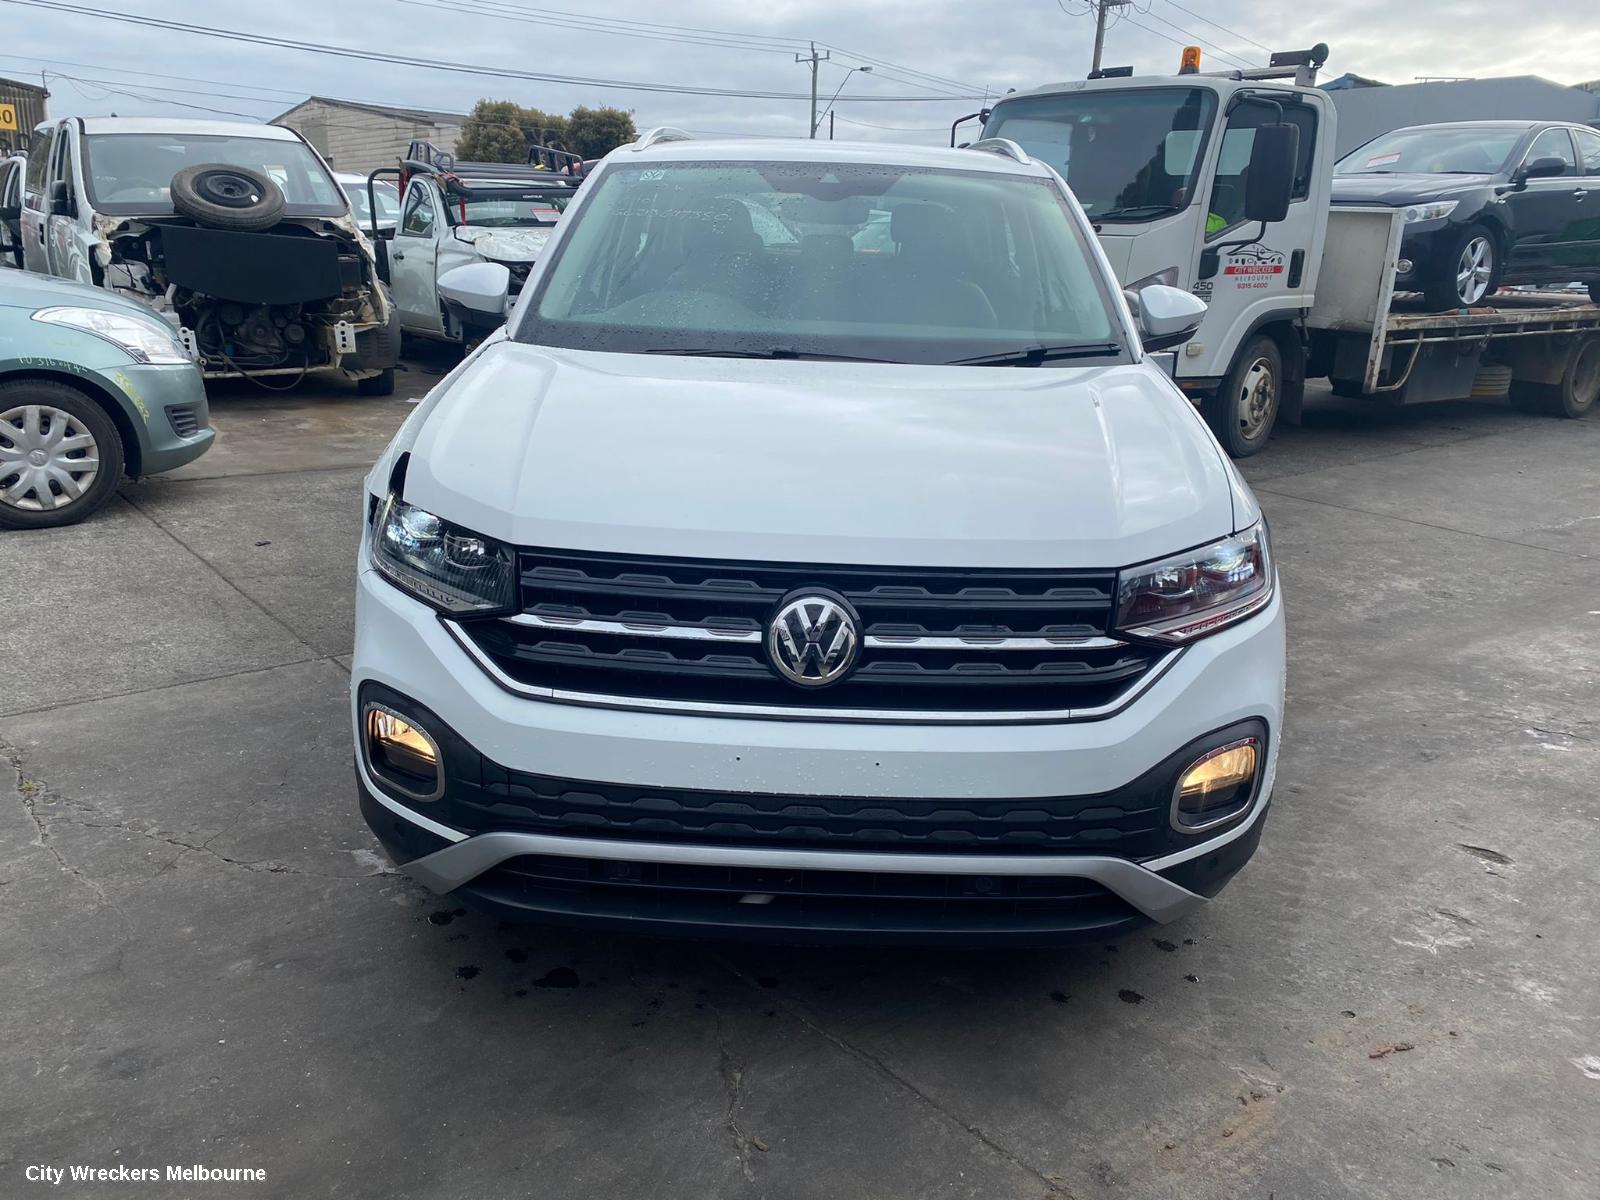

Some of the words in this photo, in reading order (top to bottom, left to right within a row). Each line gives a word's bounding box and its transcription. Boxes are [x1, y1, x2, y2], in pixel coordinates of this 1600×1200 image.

[0, 109, 12, 124] 0
[1234, 266, 1247, 274] CITY
[1248, 265, 1274, 273] WRECKERS
[1193, 282, 1213, 290] 450
